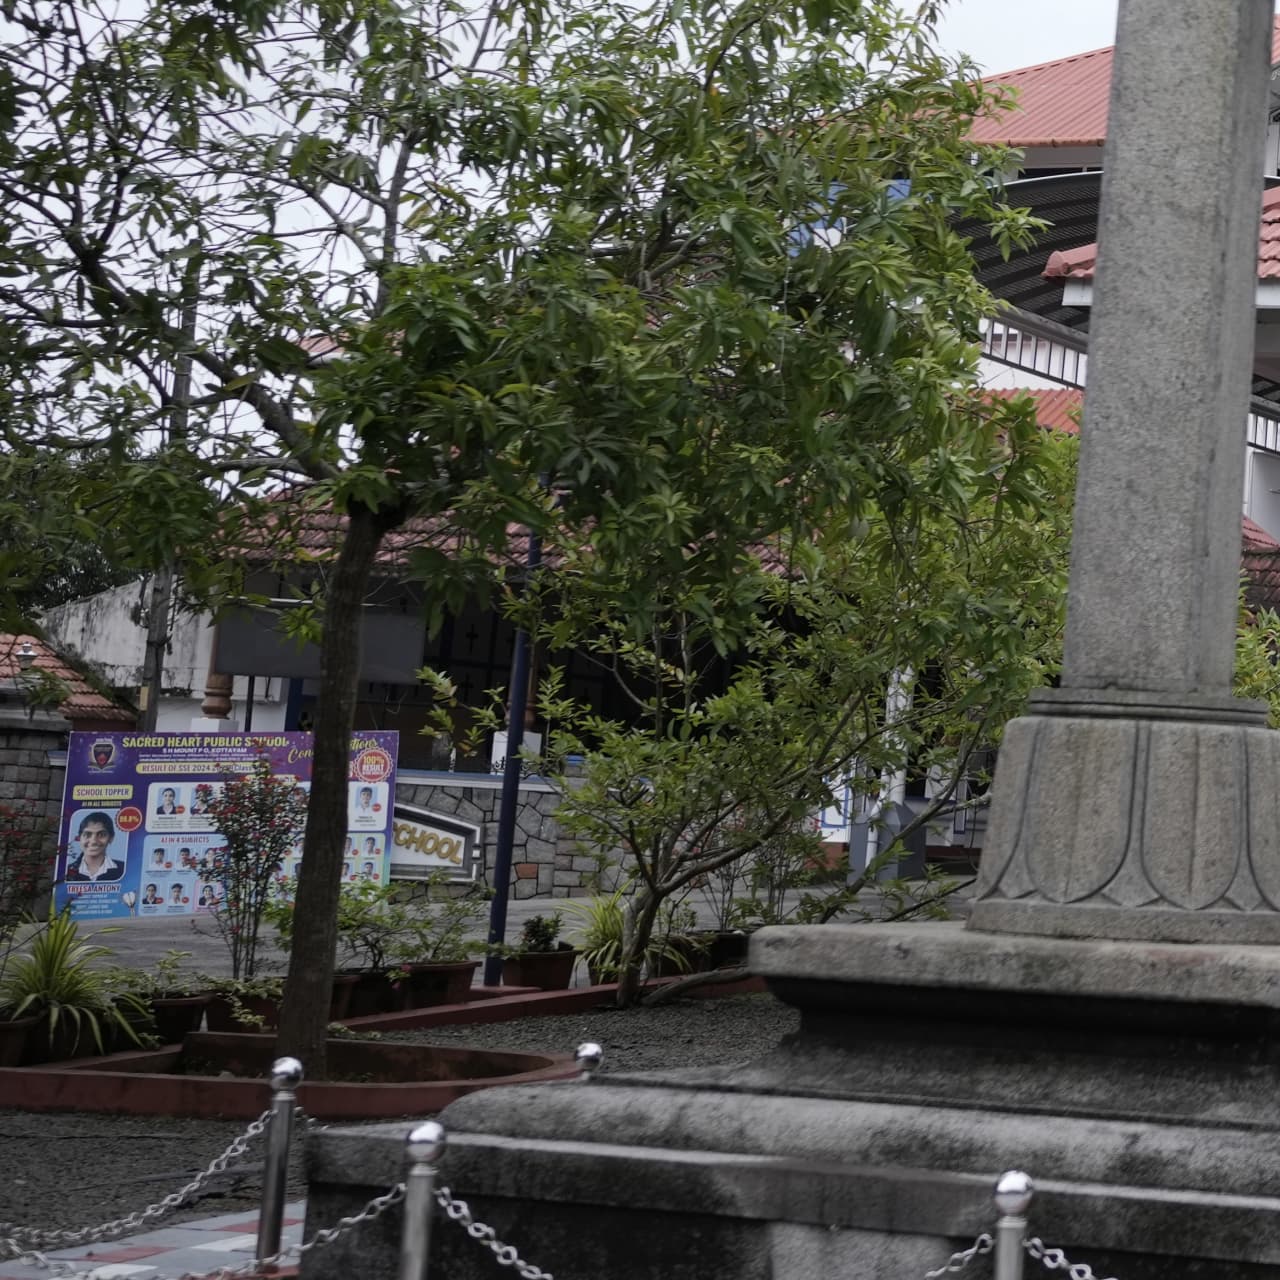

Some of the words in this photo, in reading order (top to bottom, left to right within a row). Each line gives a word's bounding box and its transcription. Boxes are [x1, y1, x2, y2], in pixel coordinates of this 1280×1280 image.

[122, 736, 165, 748] SACRED
[167, 736, 202, 747] HEART
[203, 736, 242, 747] PUBLIC
[363, 756, 385, 765] 100%
[142, 764, 167, 772] RESULT
[168, 764, 176, 772] OF
[77, 788, 103, 797] SCHOOL
[105, 787, 129, 796] TOPPER
[92, 883, 121, 893] ANTONY
